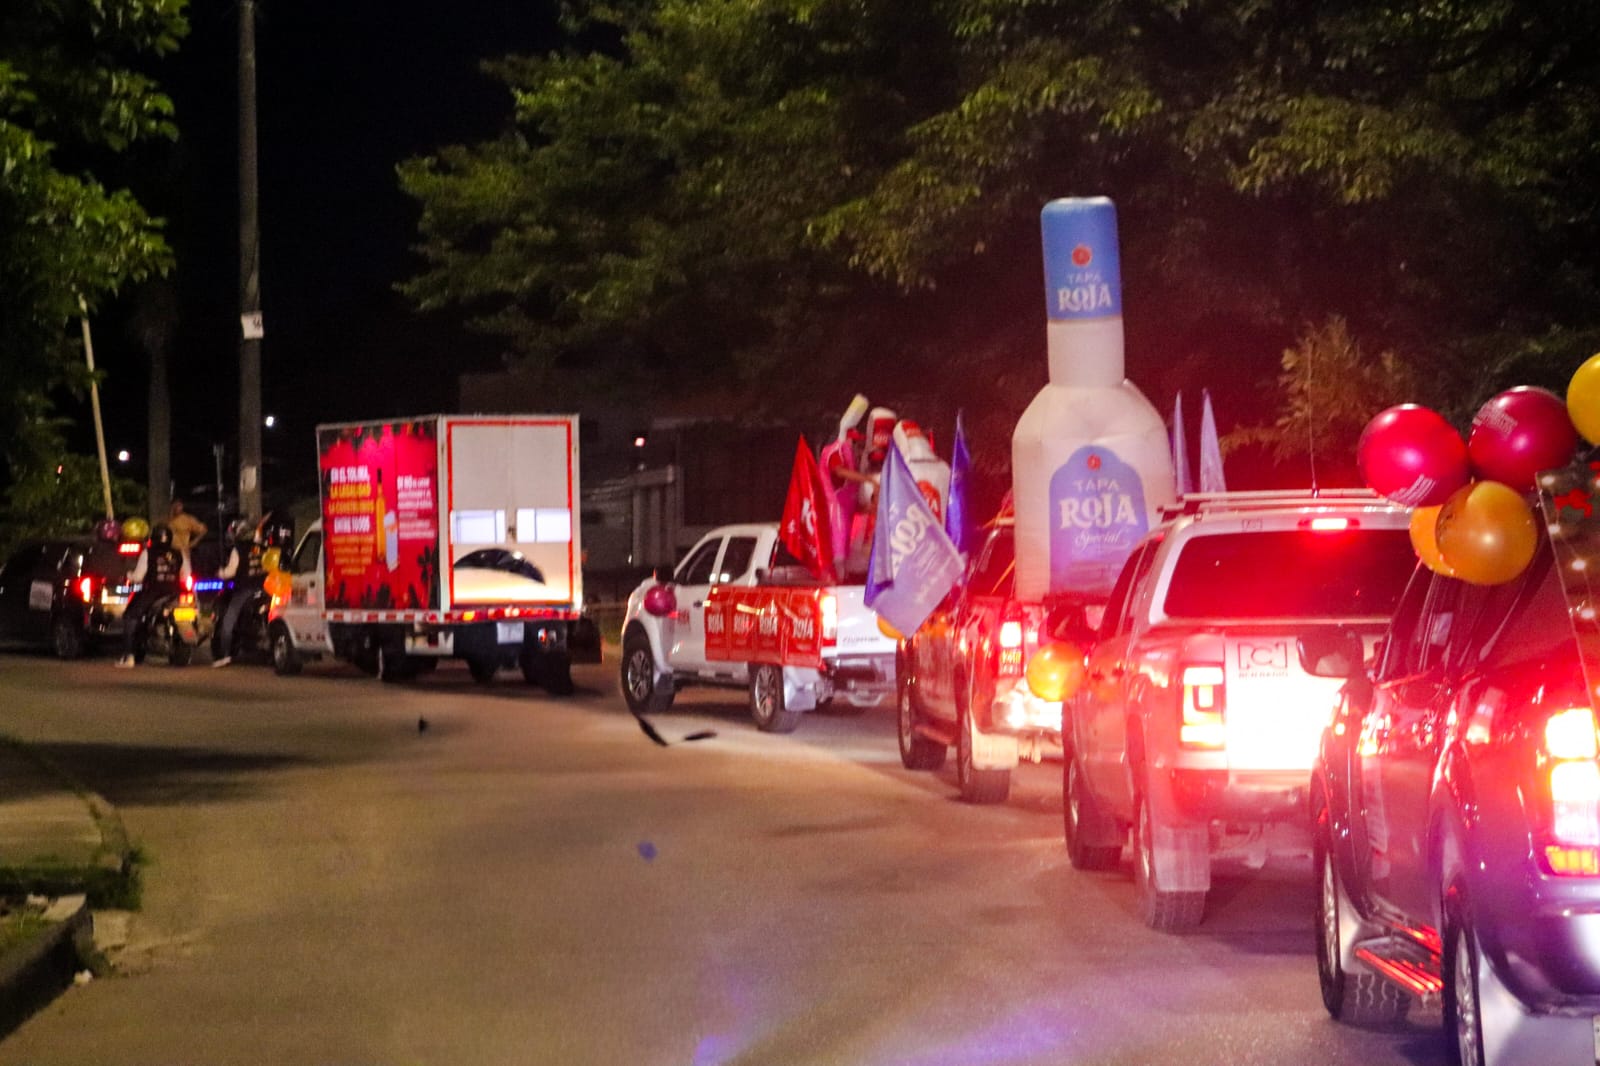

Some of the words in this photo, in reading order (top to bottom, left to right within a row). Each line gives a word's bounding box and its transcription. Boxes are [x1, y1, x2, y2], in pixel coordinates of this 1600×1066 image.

[1066, 272, 1101, 284] TAPA
[1058, 283, 1112, 312] ROJA
[1073, 479, 1120, 492] TAPA
[1059, 493, 1138, 529] ROJA
